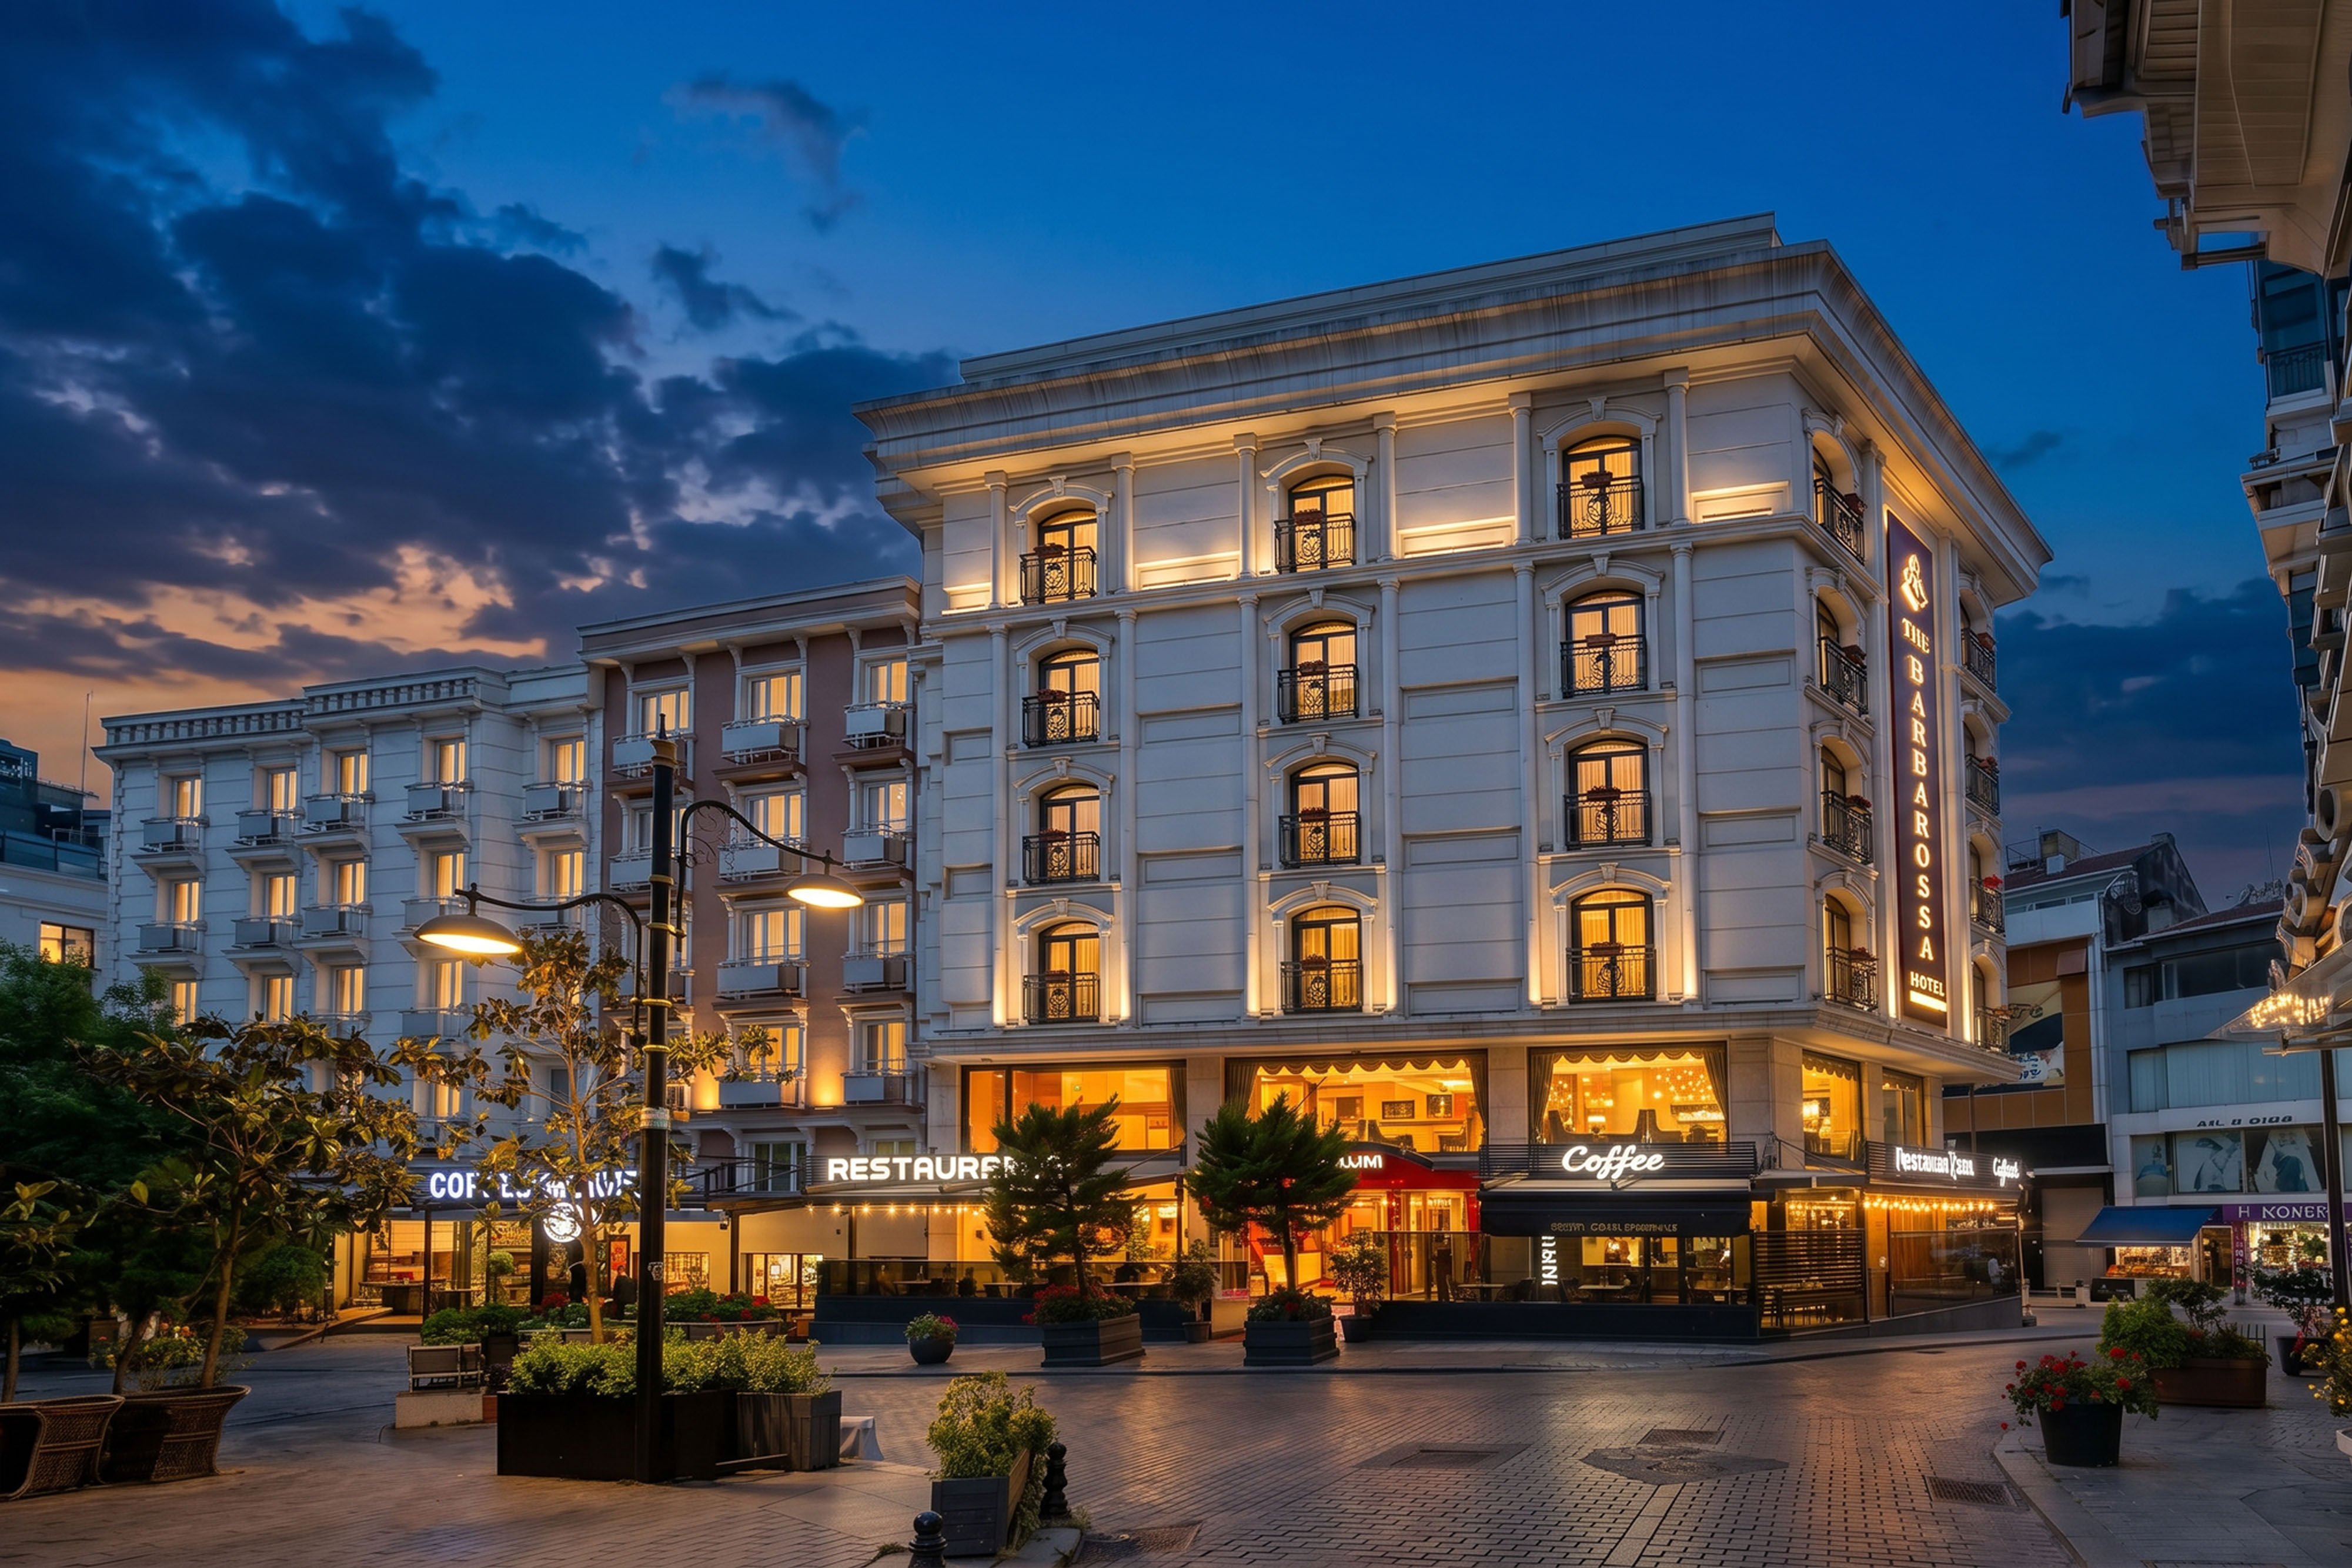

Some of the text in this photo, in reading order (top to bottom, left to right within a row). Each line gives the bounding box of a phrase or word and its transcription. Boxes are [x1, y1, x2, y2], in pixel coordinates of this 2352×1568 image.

[1902, 617, 1930, 654] THE
[1906, 654, 1934, 961] BARBAROSSA
[1910, 971, 1945, 997] HOTEL
[1562, 1145, 1665, 1179] Coffee
[2262, 1205, 2328, 1219] KONER
